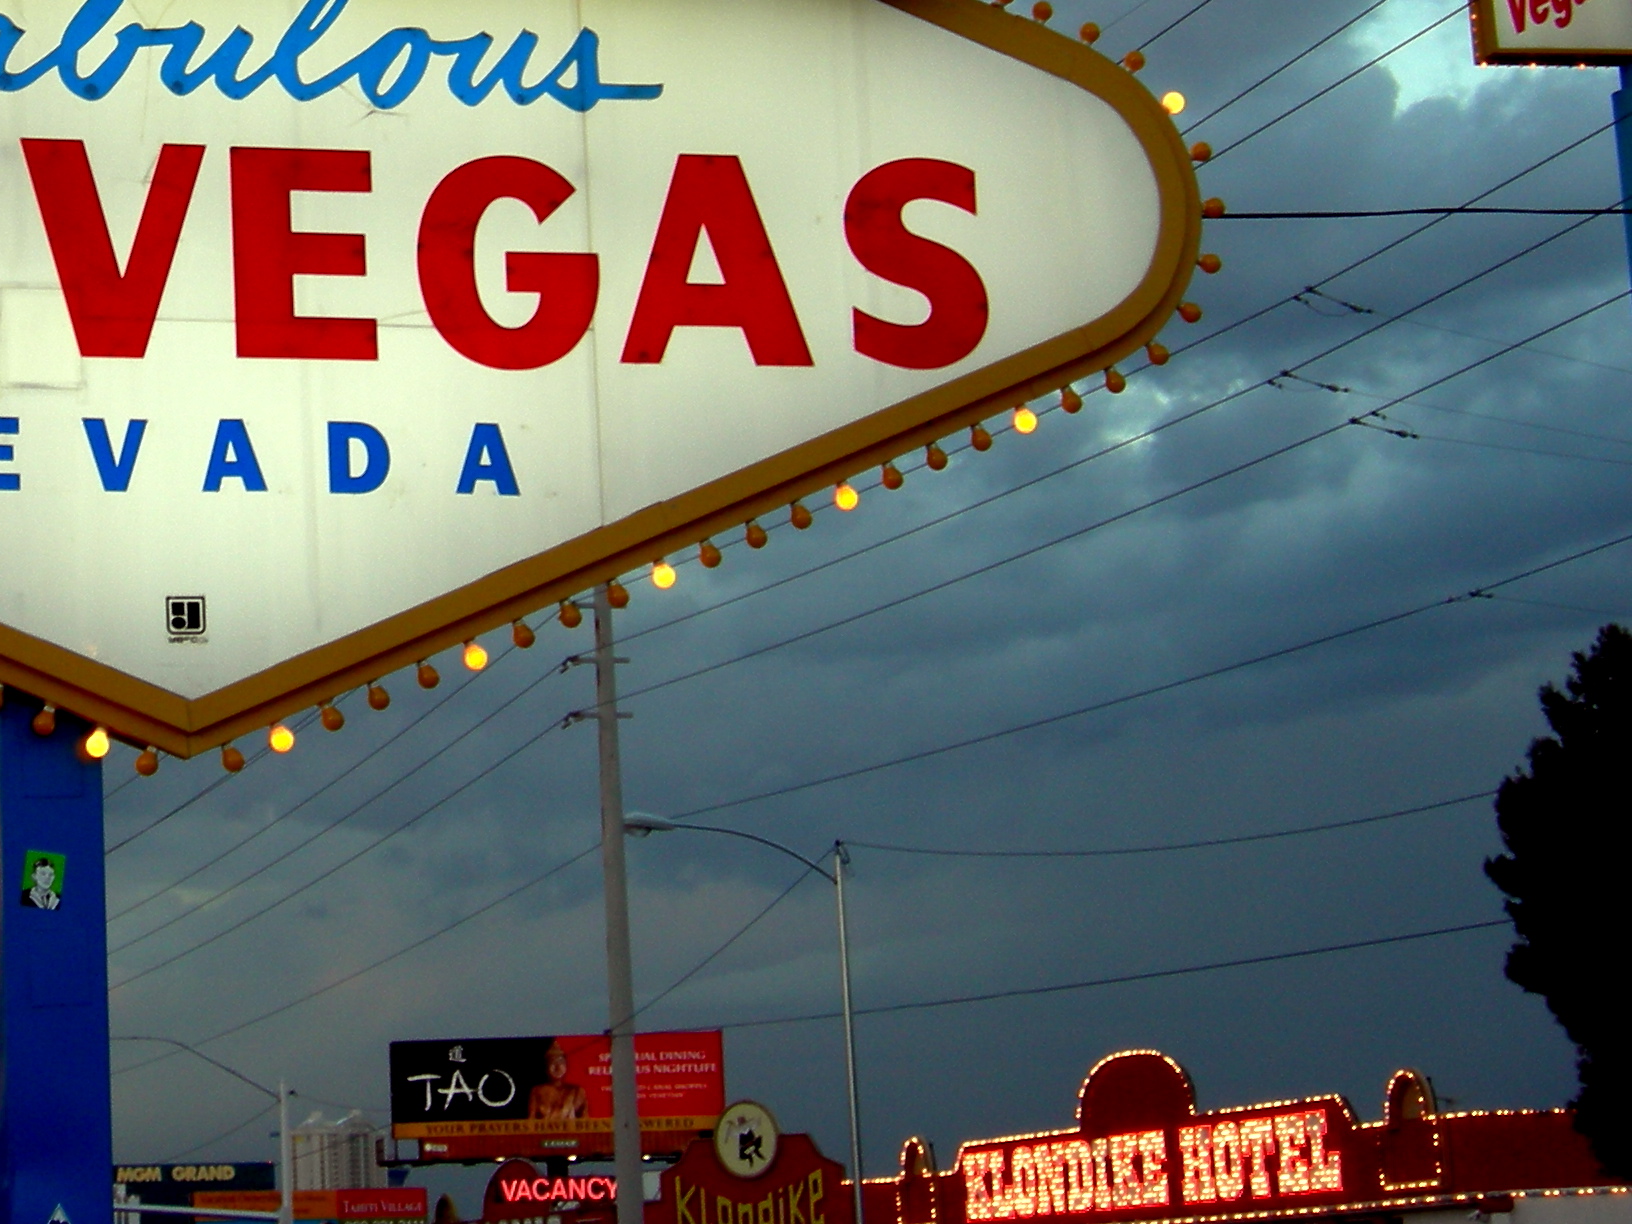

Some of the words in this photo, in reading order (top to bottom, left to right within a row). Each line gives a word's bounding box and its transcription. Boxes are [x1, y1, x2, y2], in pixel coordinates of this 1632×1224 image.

[20, 138, 990, 372] VEGAS
[659, 1051, 706, 1061] DINING
[407, 1069, 516, 1111] TAO
[425, 1124, 465, 1135] YOUR
[469, 1122, 529, 1133] PRAYERS
[534, 1121, 568, 1132] HAVE
[116, 1166, 162, 1182] MGM
[171, 1165, 236, 1181] GRAND
[962, 1128, 1169, 1223] KLONDIKE
[1178, 1108, 1344, 1206] HOTEL
[501, 1177, 618, 1201] VACANCY
